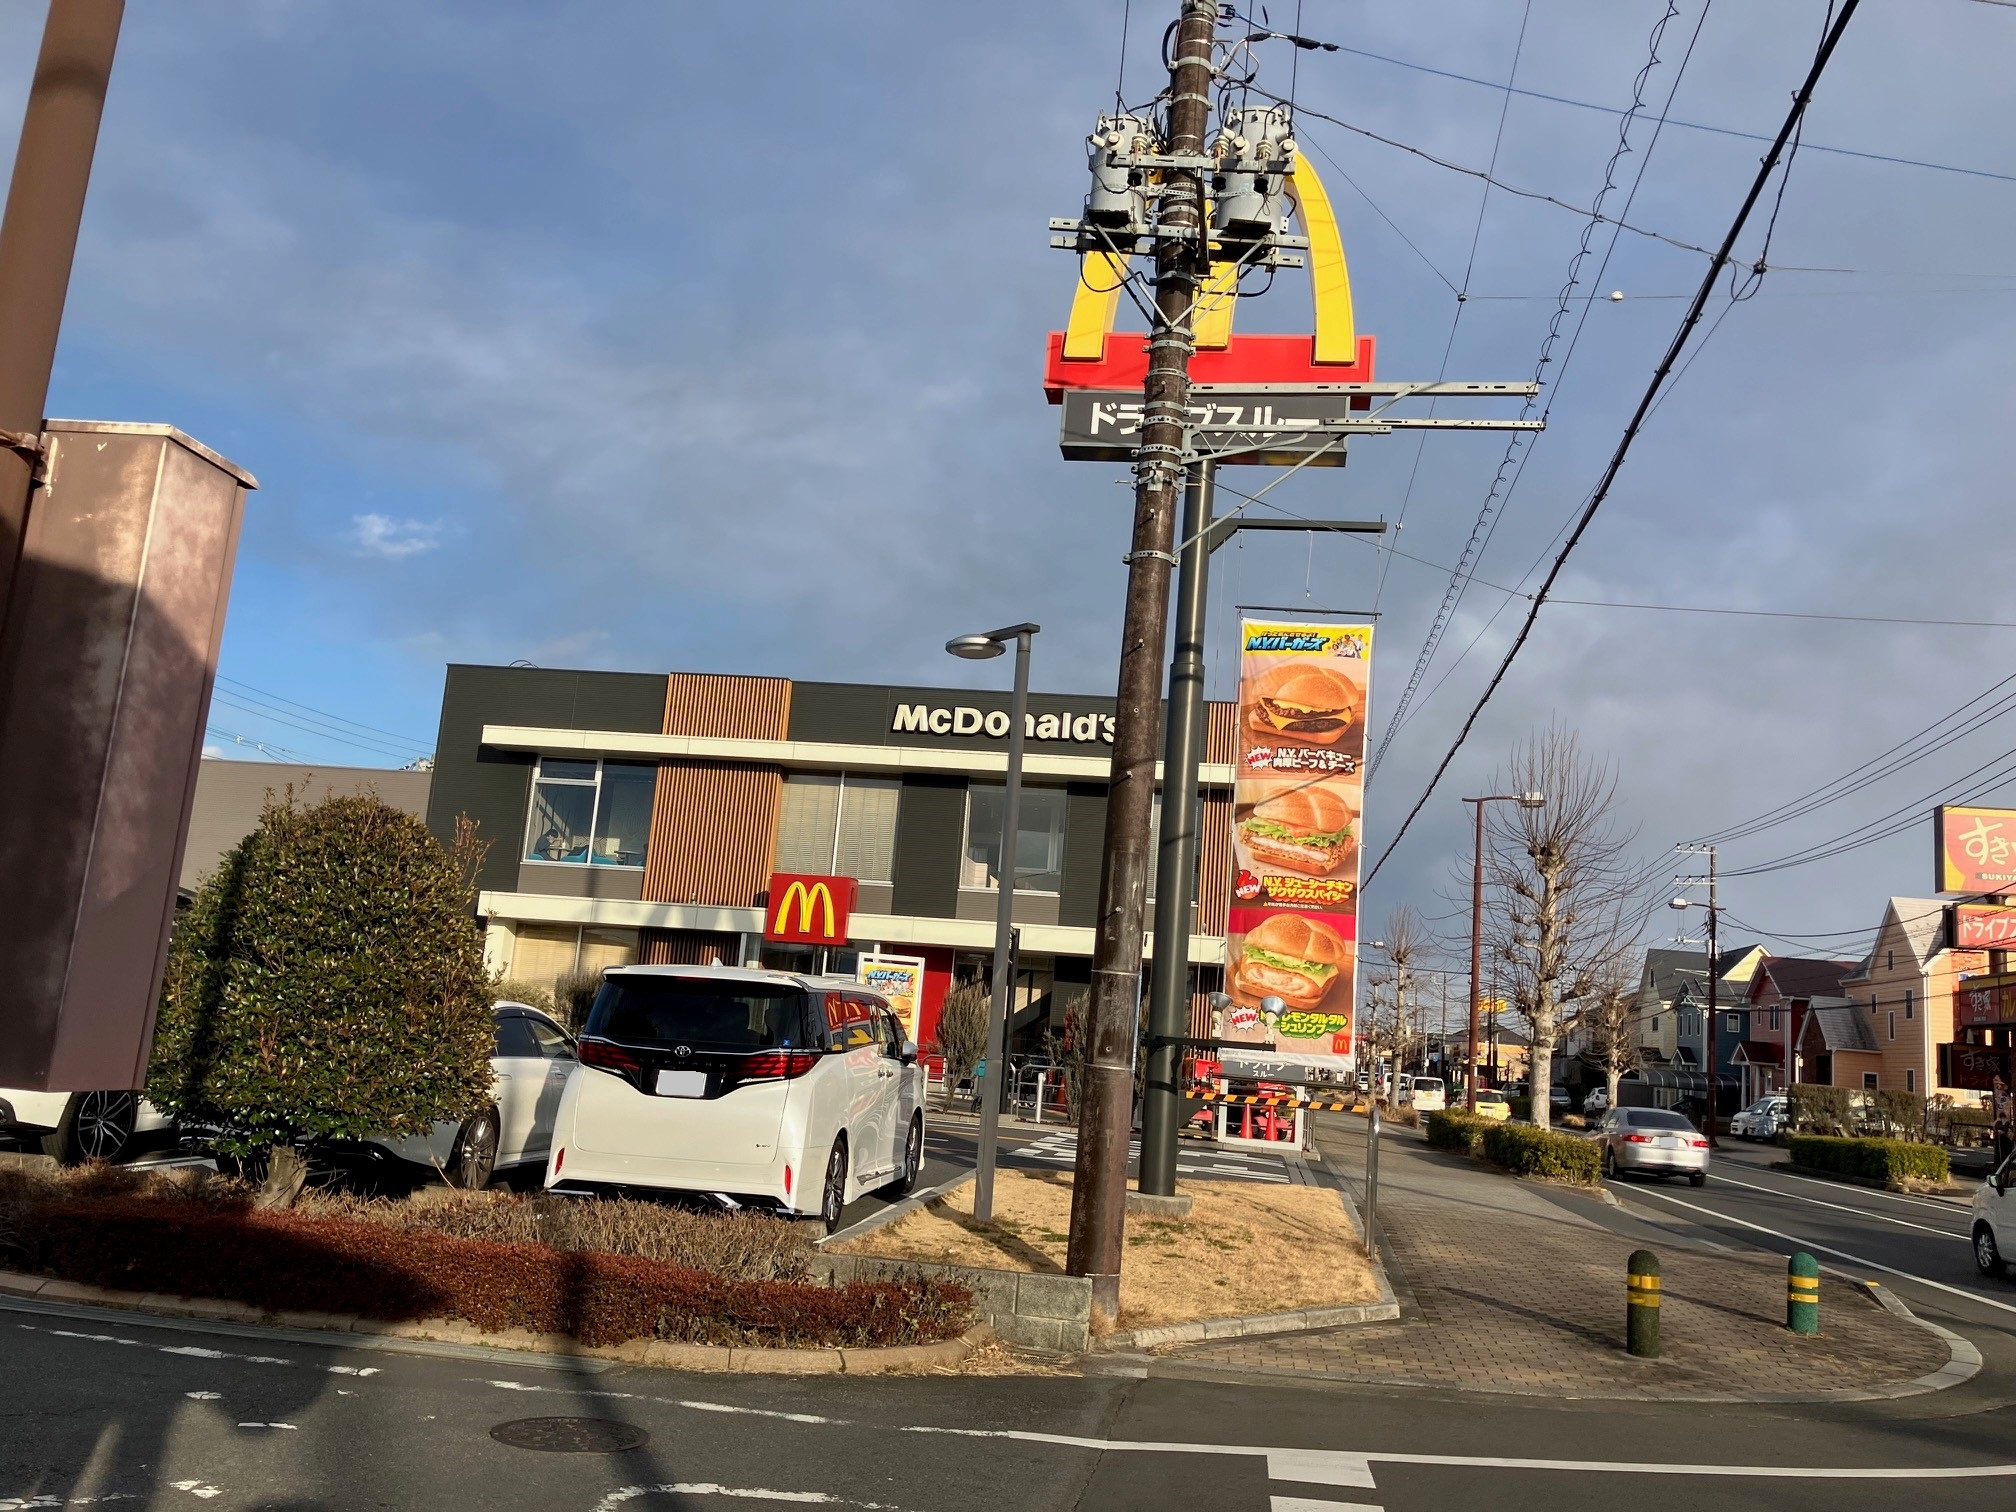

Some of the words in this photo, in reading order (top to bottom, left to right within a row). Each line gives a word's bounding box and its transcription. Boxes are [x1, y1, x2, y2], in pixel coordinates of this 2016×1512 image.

[1090, 402, 1320, 438] ドラブスルー
[1247, 752, 1272, 764] NEW
[1277, 748, 1297, 758] N.Y.
[1298, 748, 1352, 762] バーベキュー
[1958, 817, 2016, 867] すき
[1235, 884, 1261, 898] NEW
[1263, 876, 1283, 887] N.Y.
[1284, 877, 1354, 893] ジューシーチキン
[1267, 886, 1350, 901] ザクザクスパイシー
[1232, 1012, 1257, 1025] NEW
[1280, 1021, 1327, 1035] シュリンプ
[1252, 1070, 1275, 1078] スルー
